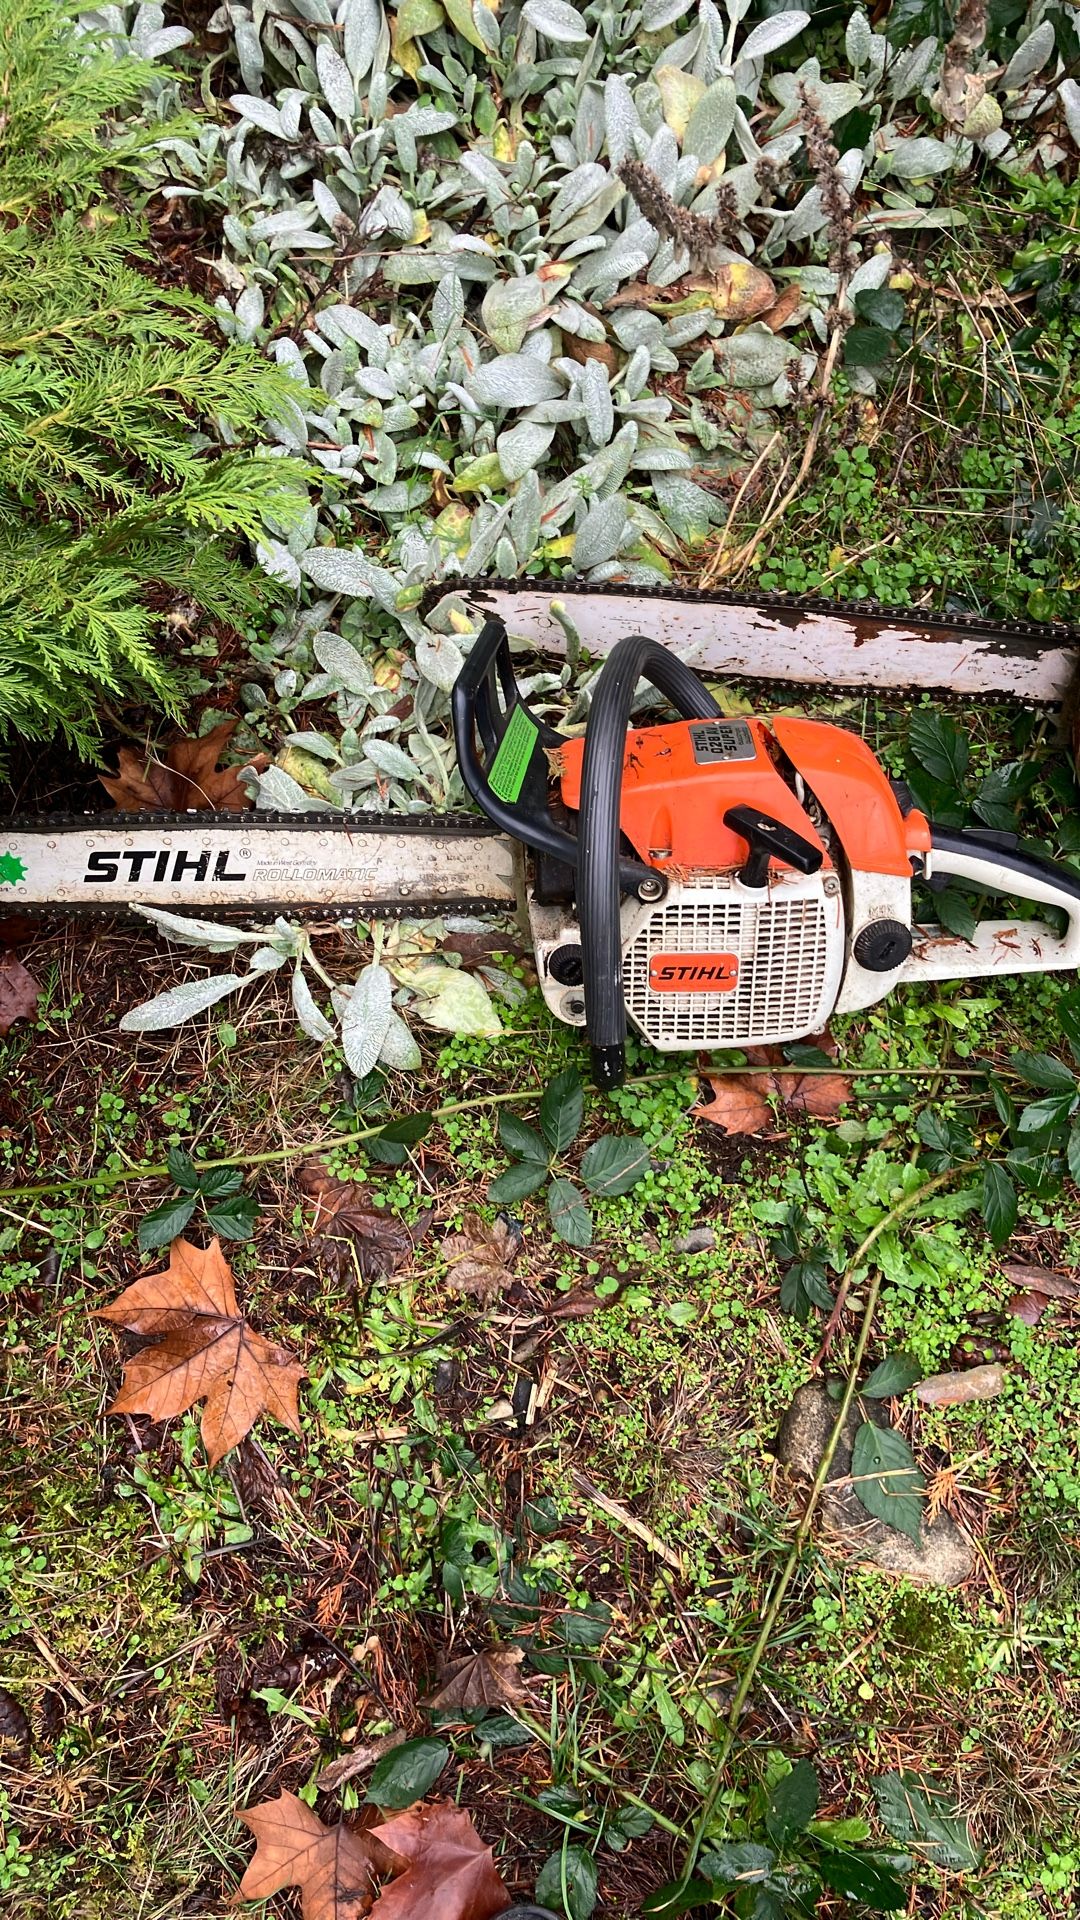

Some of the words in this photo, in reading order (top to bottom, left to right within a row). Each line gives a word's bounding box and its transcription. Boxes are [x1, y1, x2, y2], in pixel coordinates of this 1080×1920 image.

[693, 730, 709, 752] STIHL
[708, 736, 724, 754] 028
[719, 725, 737, 751] SUPER
[83, 850, 246, 882] STIHL
[252, 868, 378, 881] ROLLOMATIC
[658, 966, 729, 980] STIHL
